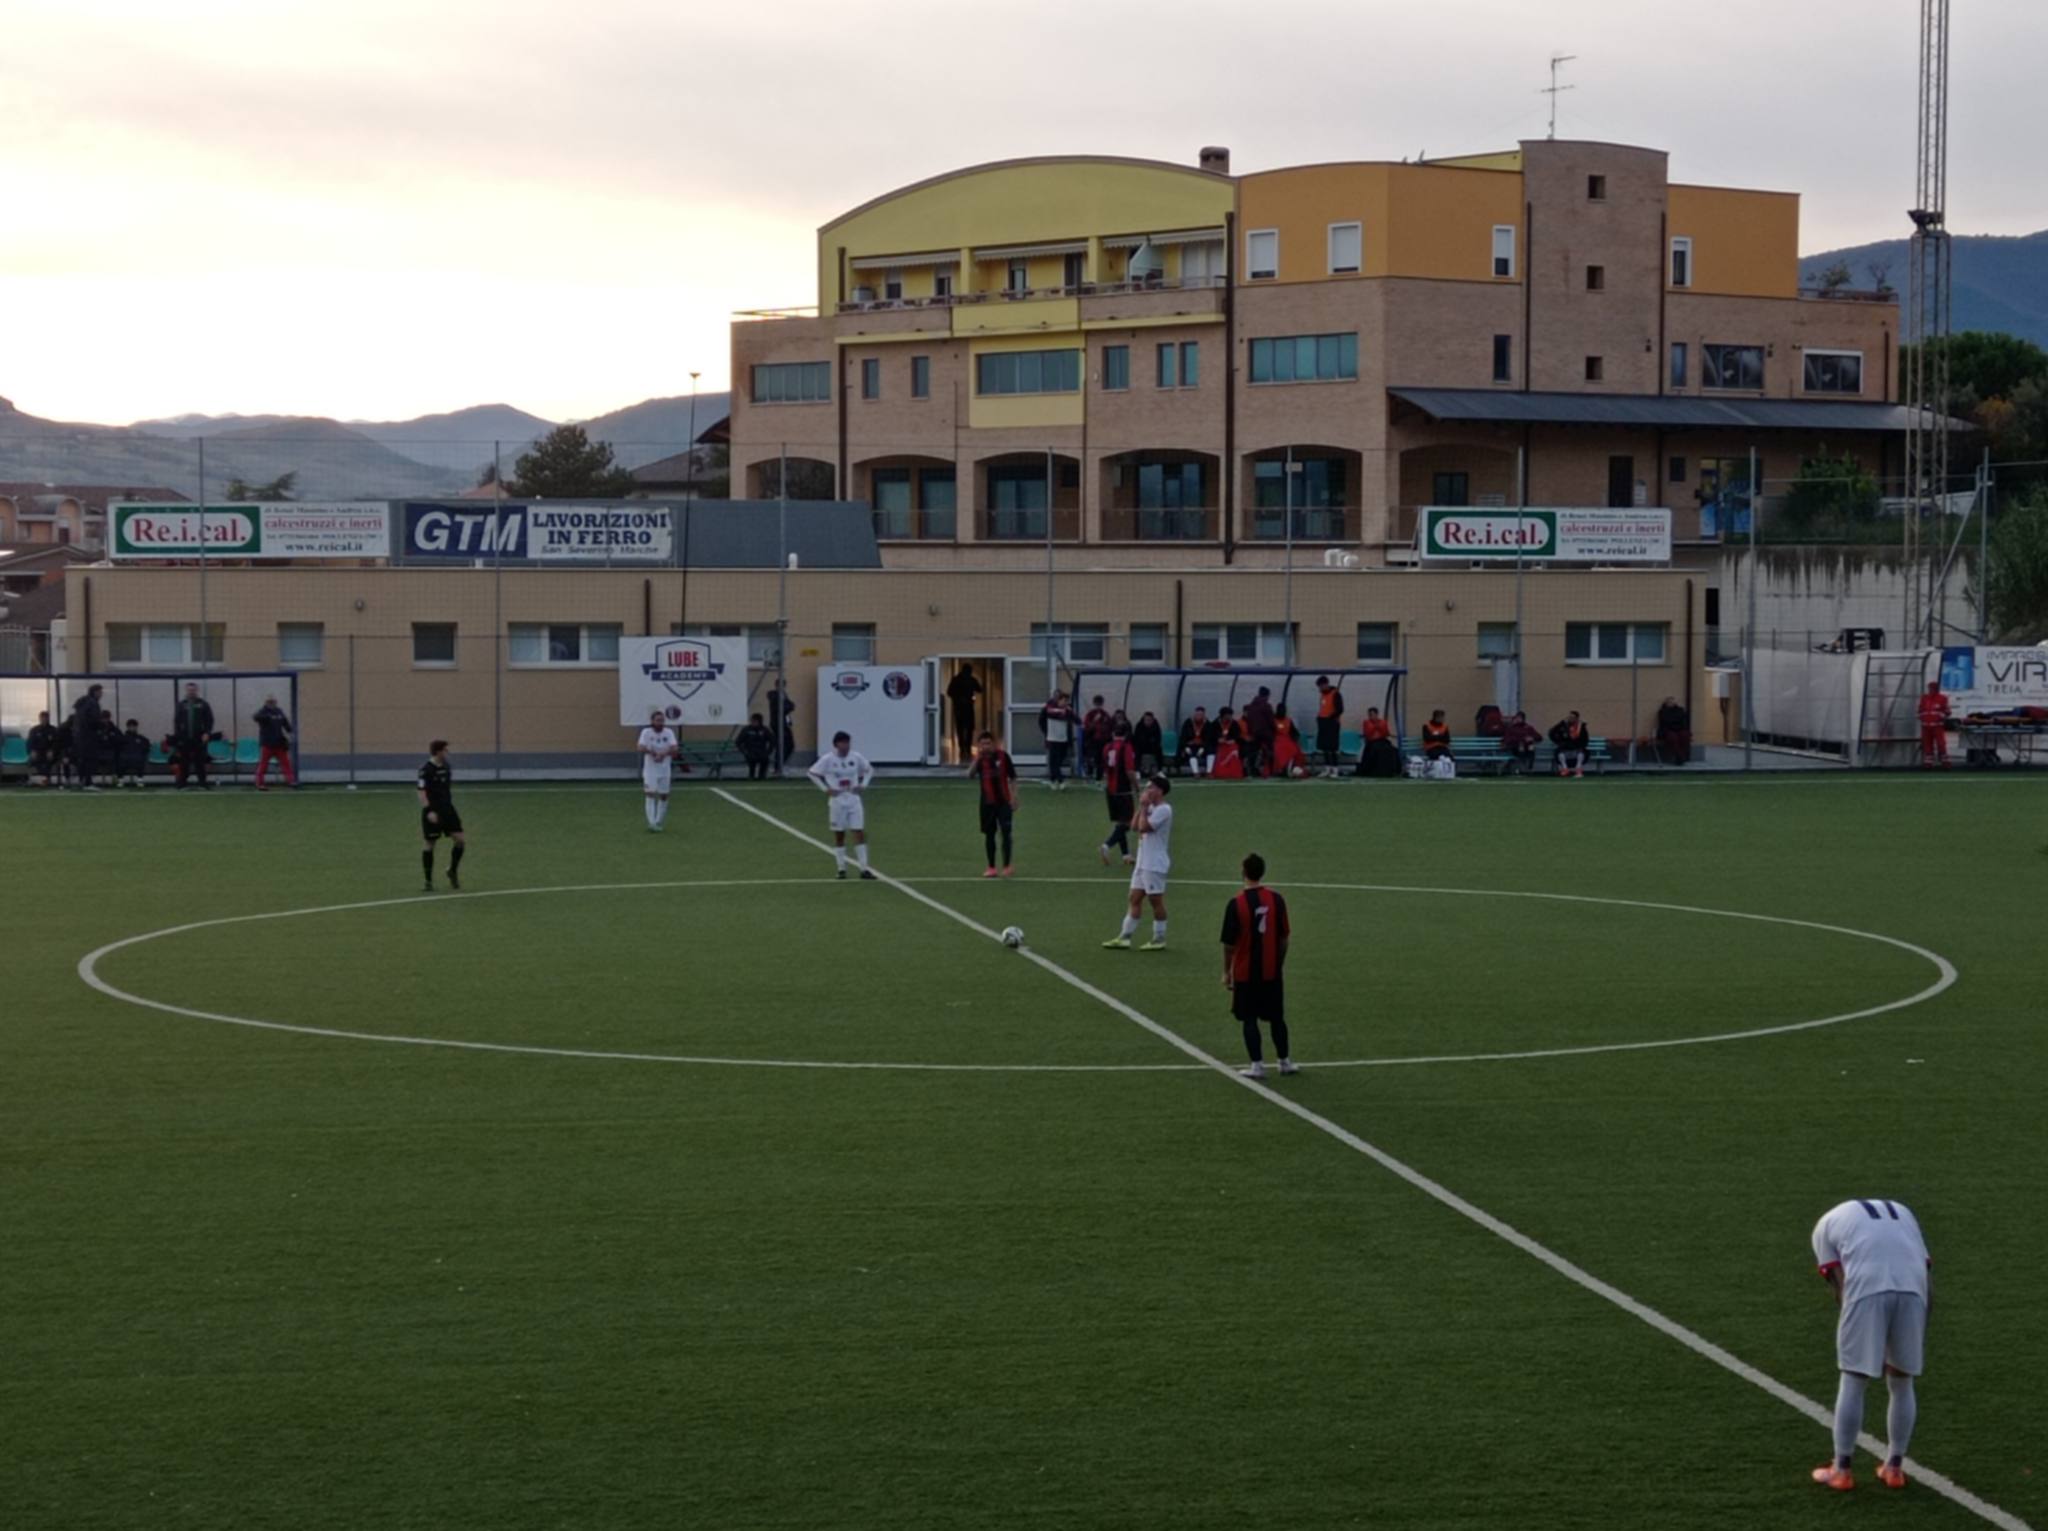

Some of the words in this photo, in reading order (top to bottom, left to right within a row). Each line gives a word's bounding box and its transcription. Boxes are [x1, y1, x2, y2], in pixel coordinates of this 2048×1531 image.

[264, 518, 336, 529] calcestruzzi
[339, 520, 346, 529] e
[349, 518, 384, 529] inerti
[533, 512, 668, 529] LAVORAZIONI
[1560, 522, 1624, 533] calcestruzzi
[1626, 525, 1633, 533] e
[1635, 522, 1665, 533] inerti
[132, 518, 247, 542] Re.i.cal.
[414, 511, 522, 551] GTM
[548, 529, 572, 545] IN
[577, 529, 653, 545] FERRO
[1443, 522, 1543, 546] Re.i.cal.
[285, 541, 363, 552] www.reical.it
[1577, 546, 1648, 556] www.reical.it
[668, 651, 699, 667] LUBE
[1255, 906, 1269, 934] 7
